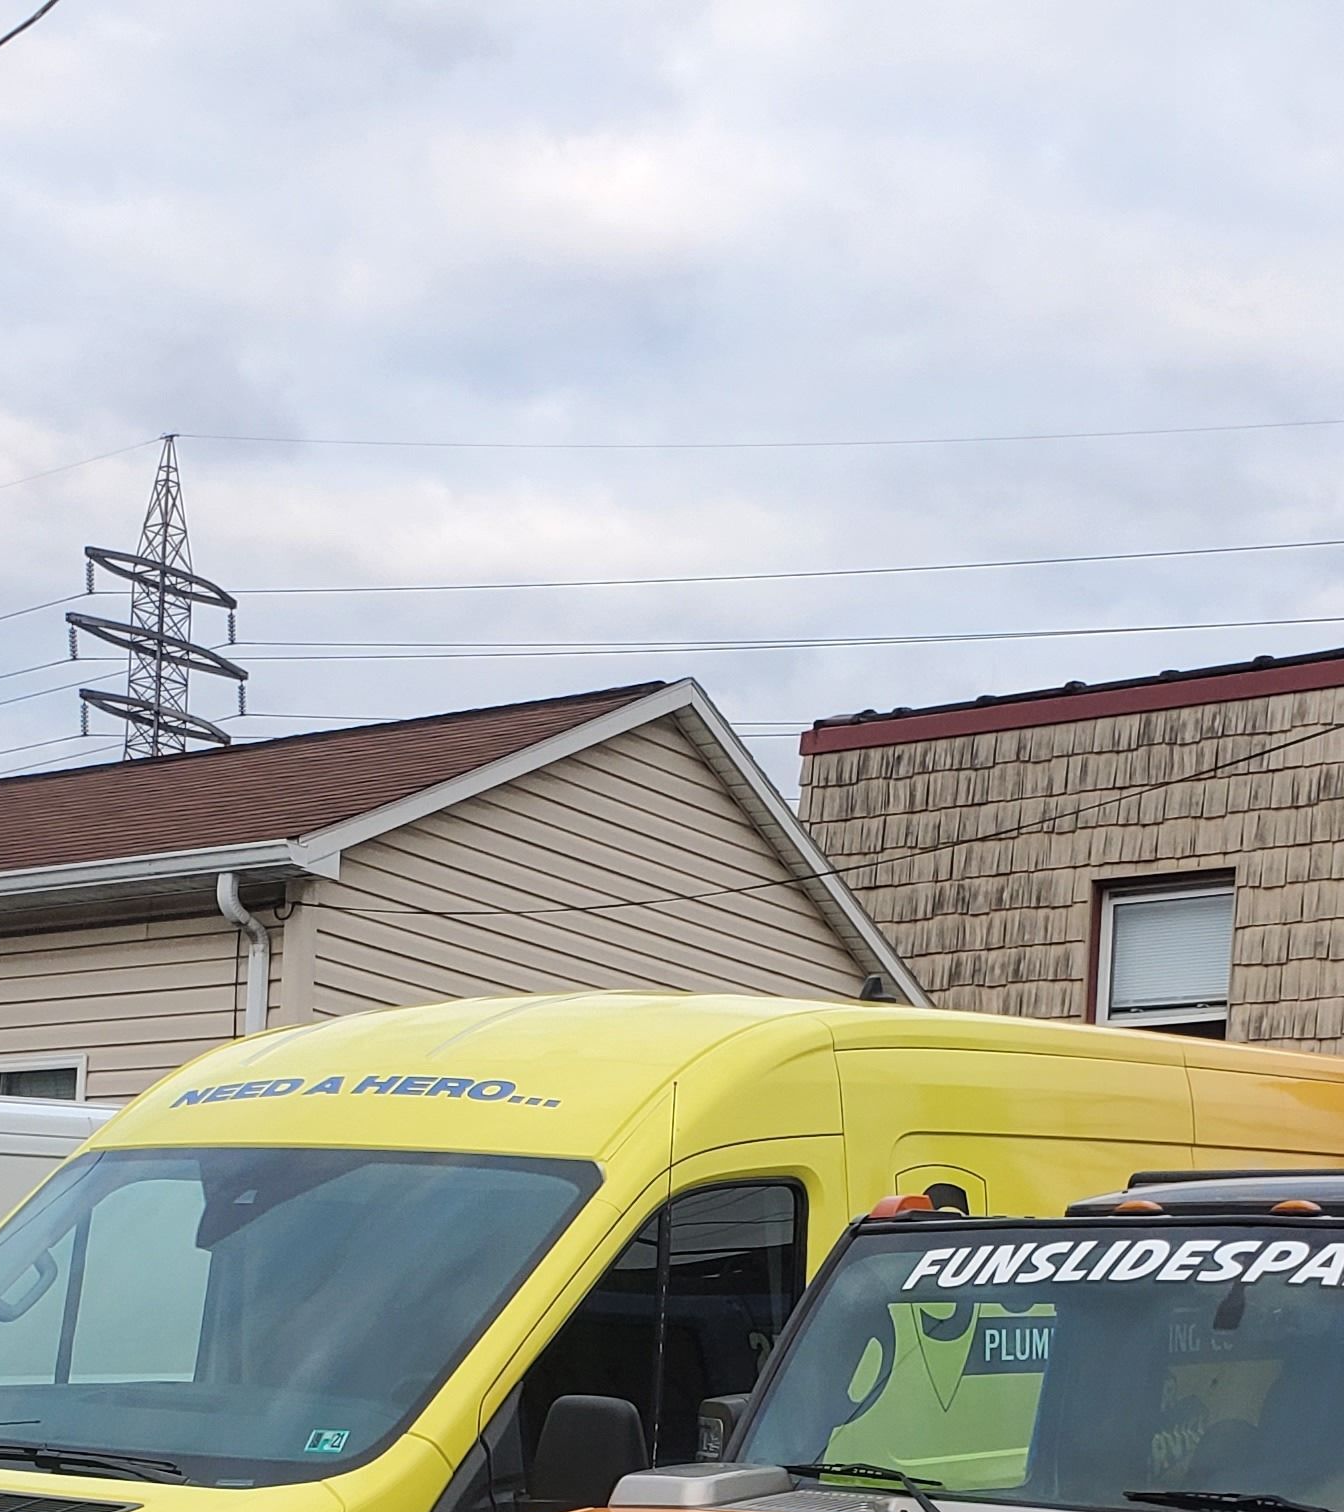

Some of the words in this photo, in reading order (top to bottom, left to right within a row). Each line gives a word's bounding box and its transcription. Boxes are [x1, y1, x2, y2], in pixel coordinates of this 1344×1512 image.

[169, 1076, 305, 1109] NEED
[302, 1075, 345, 1095] A
[351, 1074, 562, 1109] HERO...
